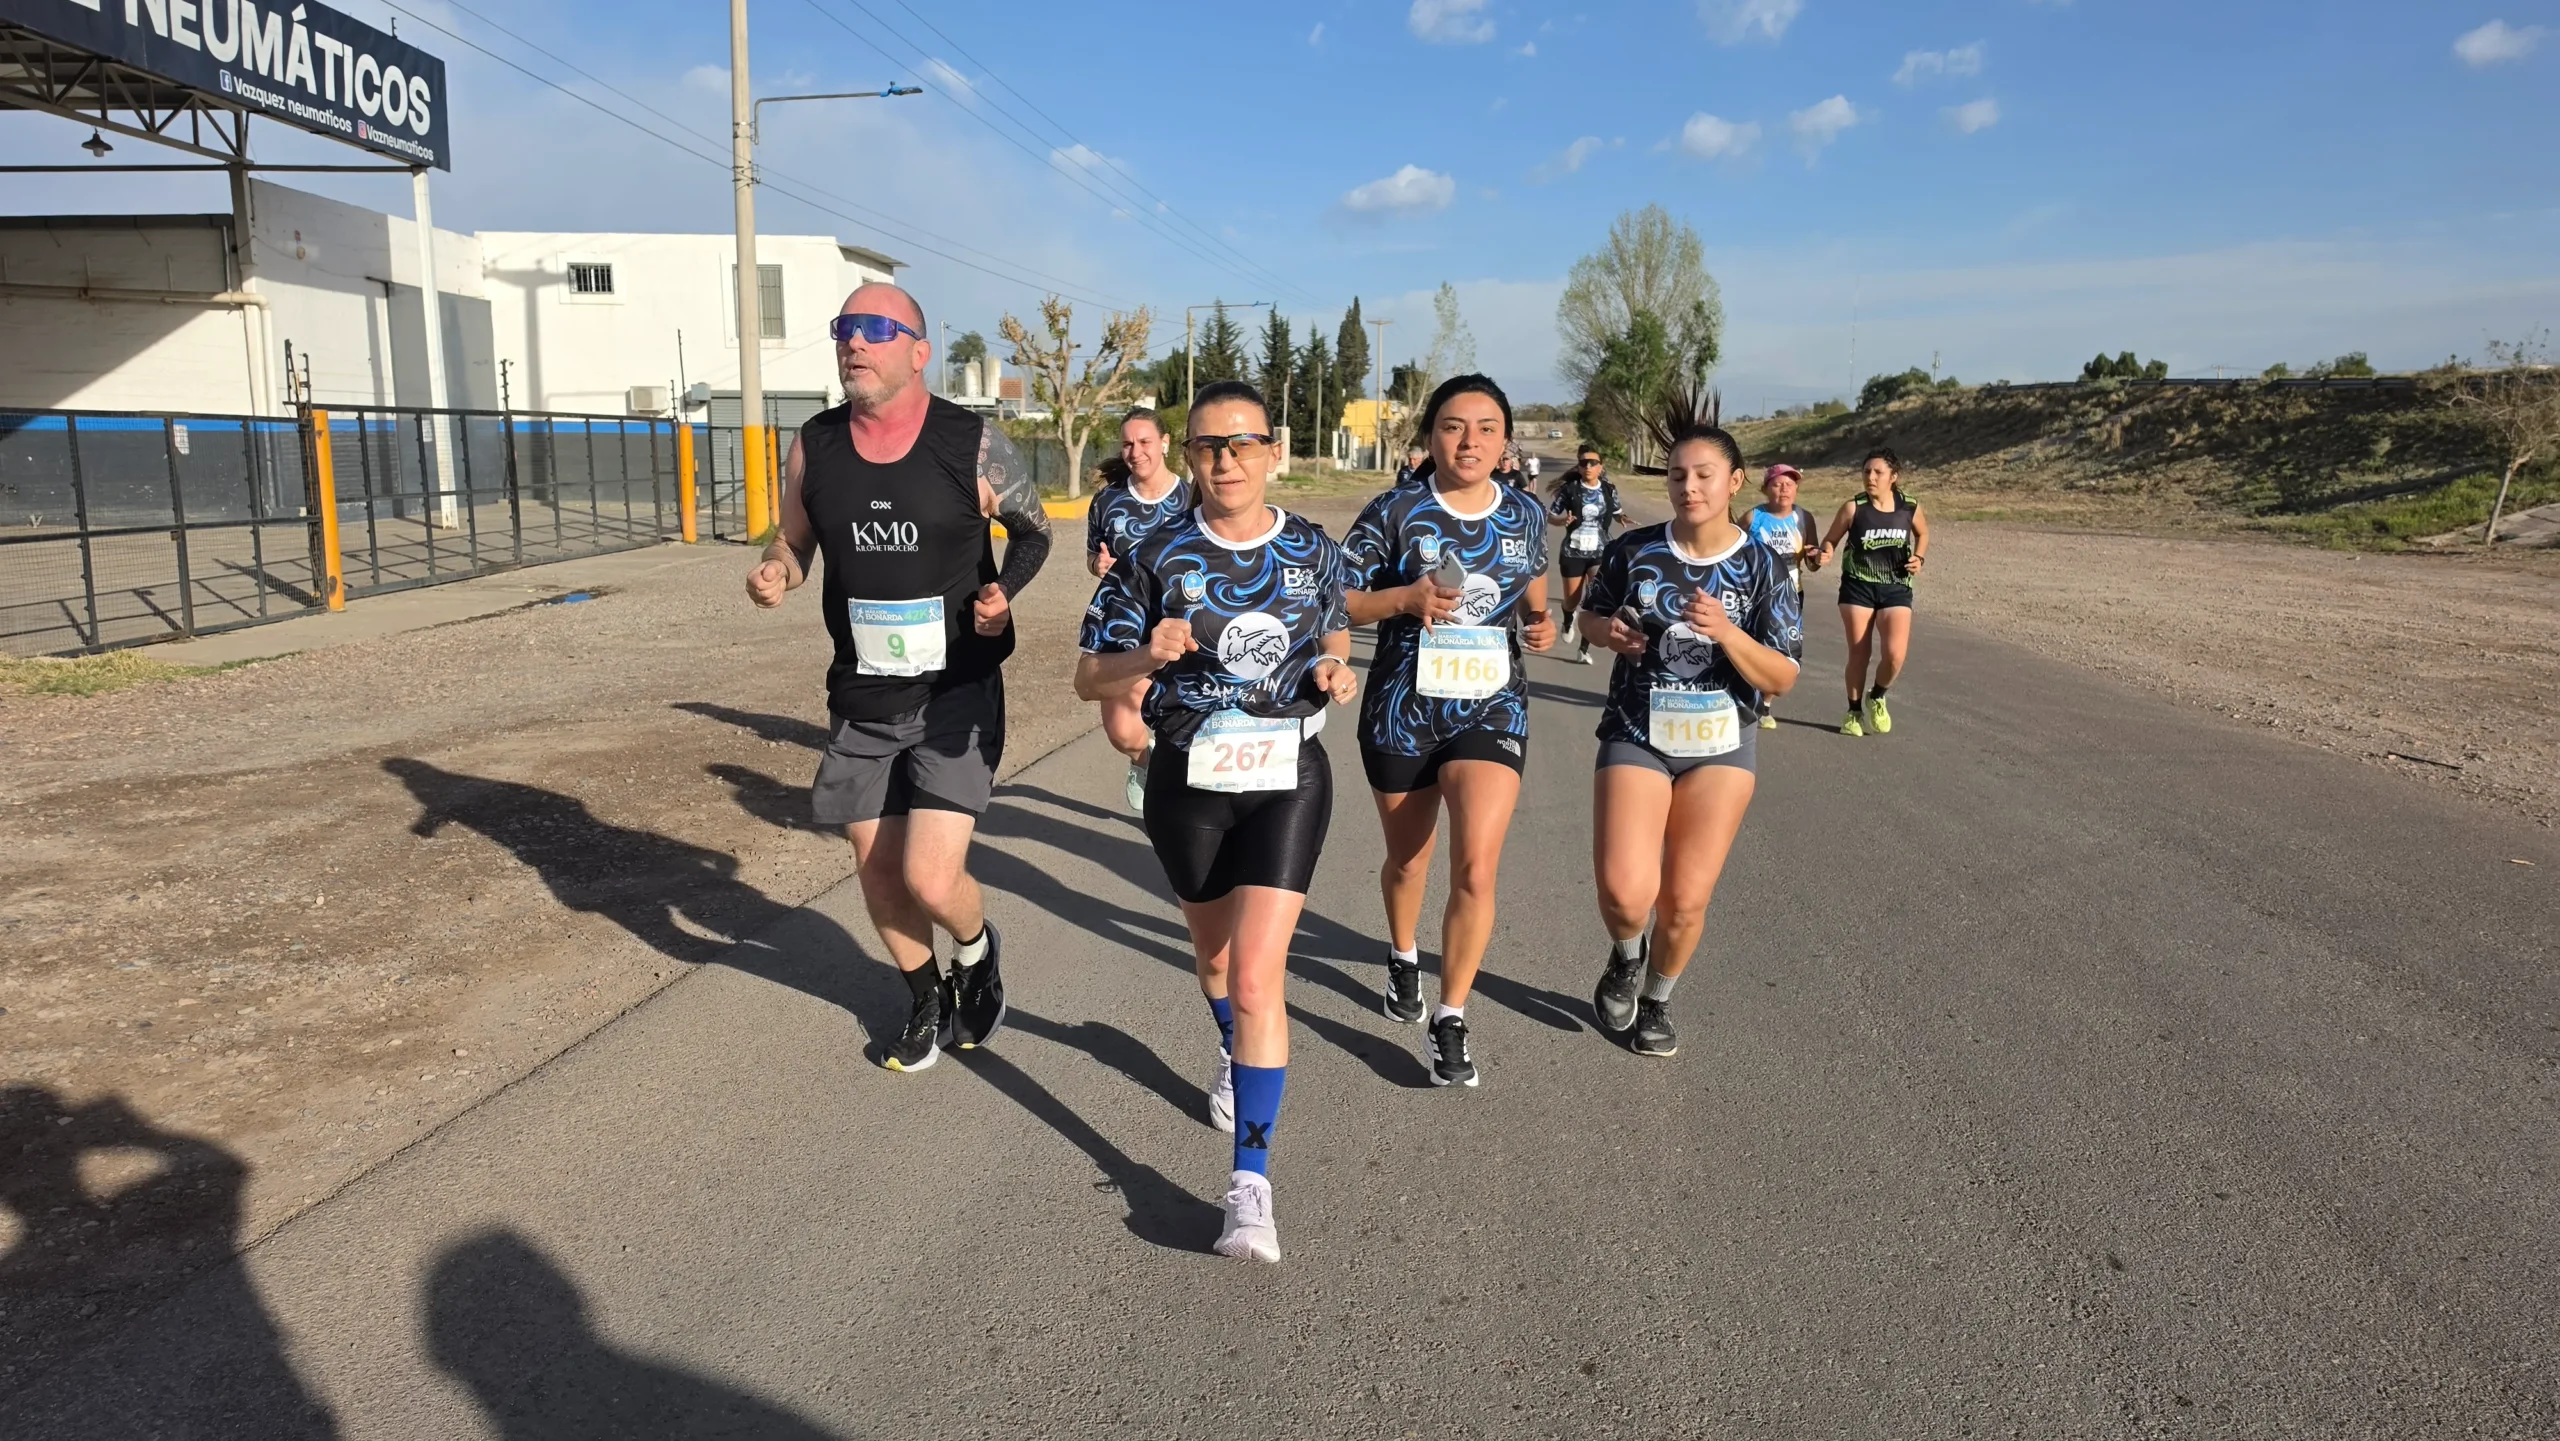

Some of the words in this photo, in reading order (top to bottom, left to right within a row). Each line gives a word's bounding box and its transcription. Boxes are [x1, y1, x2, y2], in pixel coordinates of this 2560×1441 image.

[233, 76, 285, 108] Vazquez
[287, 99, 352, 133] neumaticos
[366, 124, 434, 161] Vazneumaticos
[1860, 528, 1907, 541] JUNIN
[1862, 538, 1905, 550] Running
[865, 613, 904, 621] BONARDA
[887, 633, 905, 659] 9
[1431, 656, 1499, 682] 1166
[1667, 701, 1705, 709] BONARDA
[1211, 719, 1257, 729] BONARDA
[1663, 716, 1730, 741] 1167
[1212, 740, 1276, 772] 267
